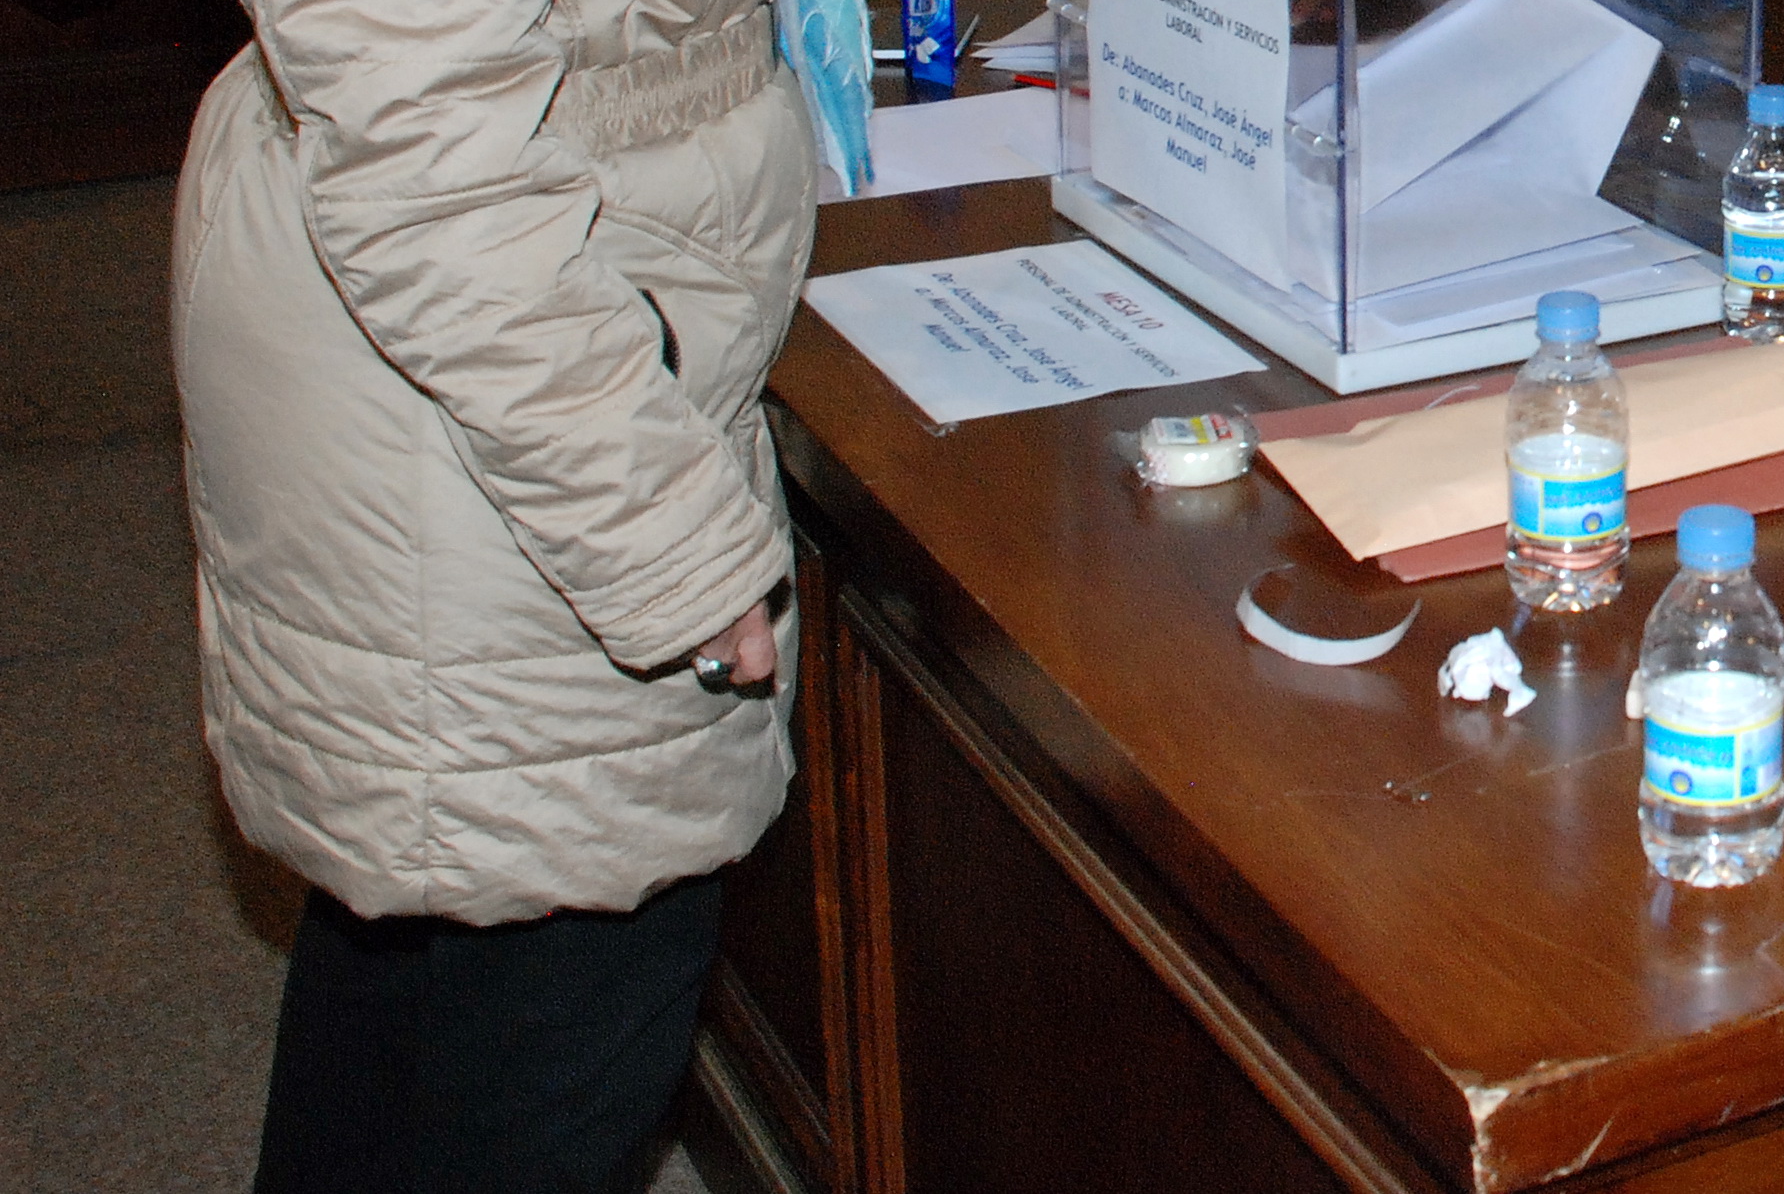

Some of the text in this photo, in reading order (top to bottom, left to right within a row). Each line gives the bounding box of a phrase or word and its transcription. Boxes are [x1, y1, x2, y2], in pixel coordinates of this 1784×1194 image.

[1165, 12, 1203, 44] LABORAL
[1226, 17, 1232, 33] Y
[1234, 21, 1280, 55] SERVICIOS
[1102, 42, 1273, 149] De: Abanades Cruz, José Ángel
[1118, 86, 1256, 170] a: Marcos Almaraz, José
[1166, 137, 1208, 174] Manuel
[1095, 291, 1164, 330] MESA 10
